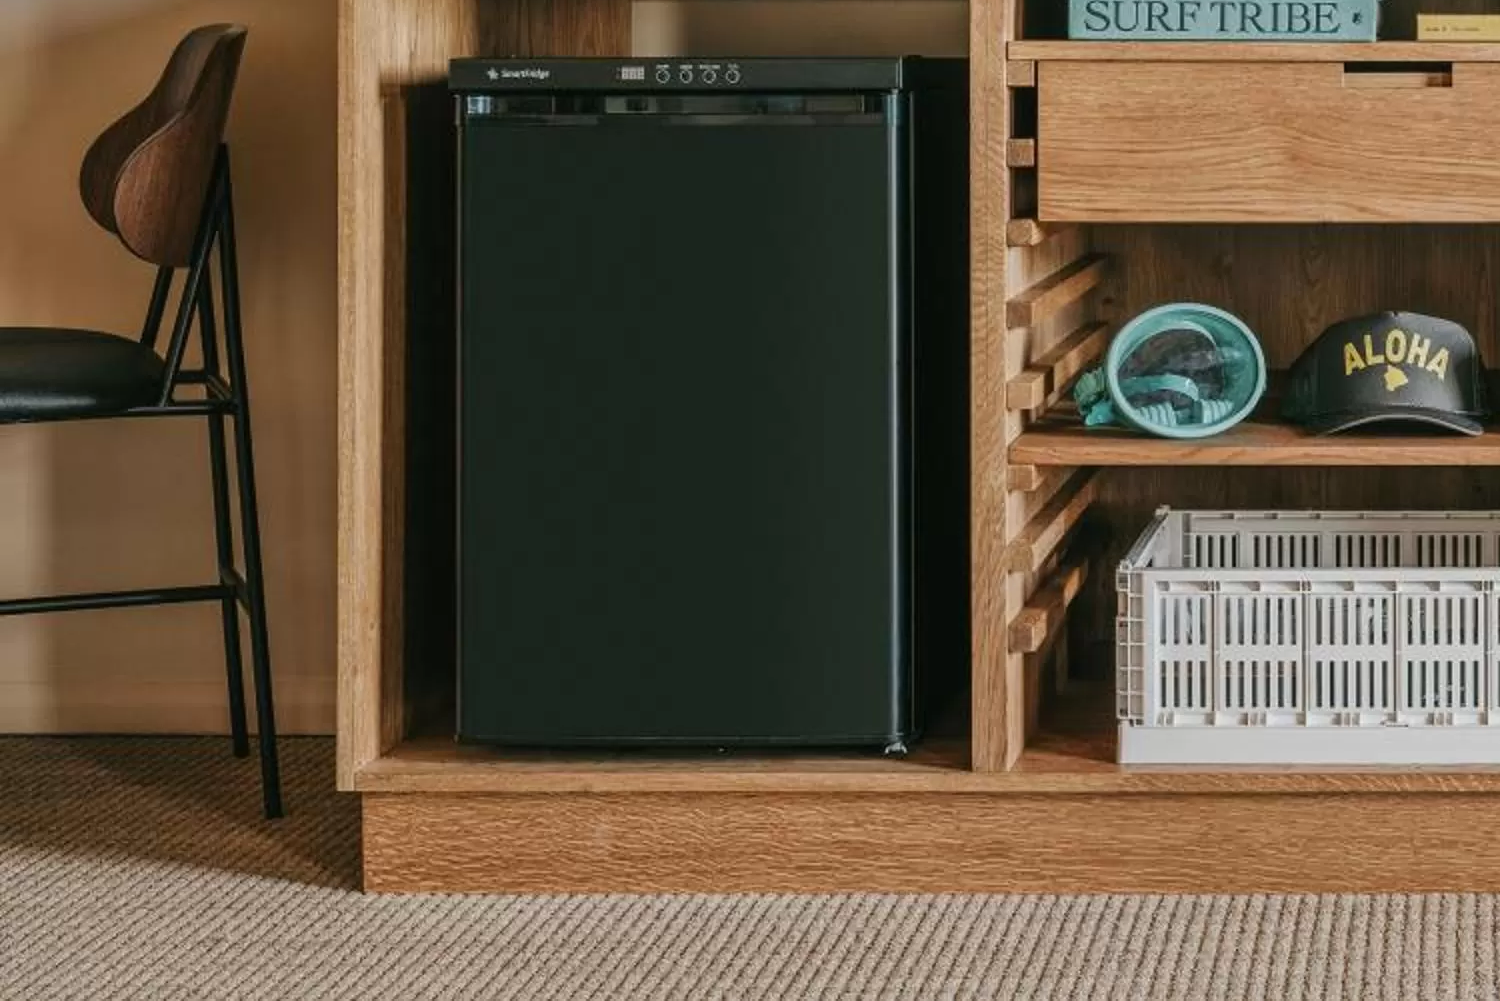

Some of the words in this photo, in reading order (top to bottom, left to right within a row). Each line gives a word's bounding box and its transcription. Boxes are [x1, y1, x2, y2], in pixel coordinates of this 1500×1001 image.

[1084, 0, 1201, 33] SURF
[1210, 1, 1341, 34] TRIBE
[1344, 328, 1450, 382] ALOHA
